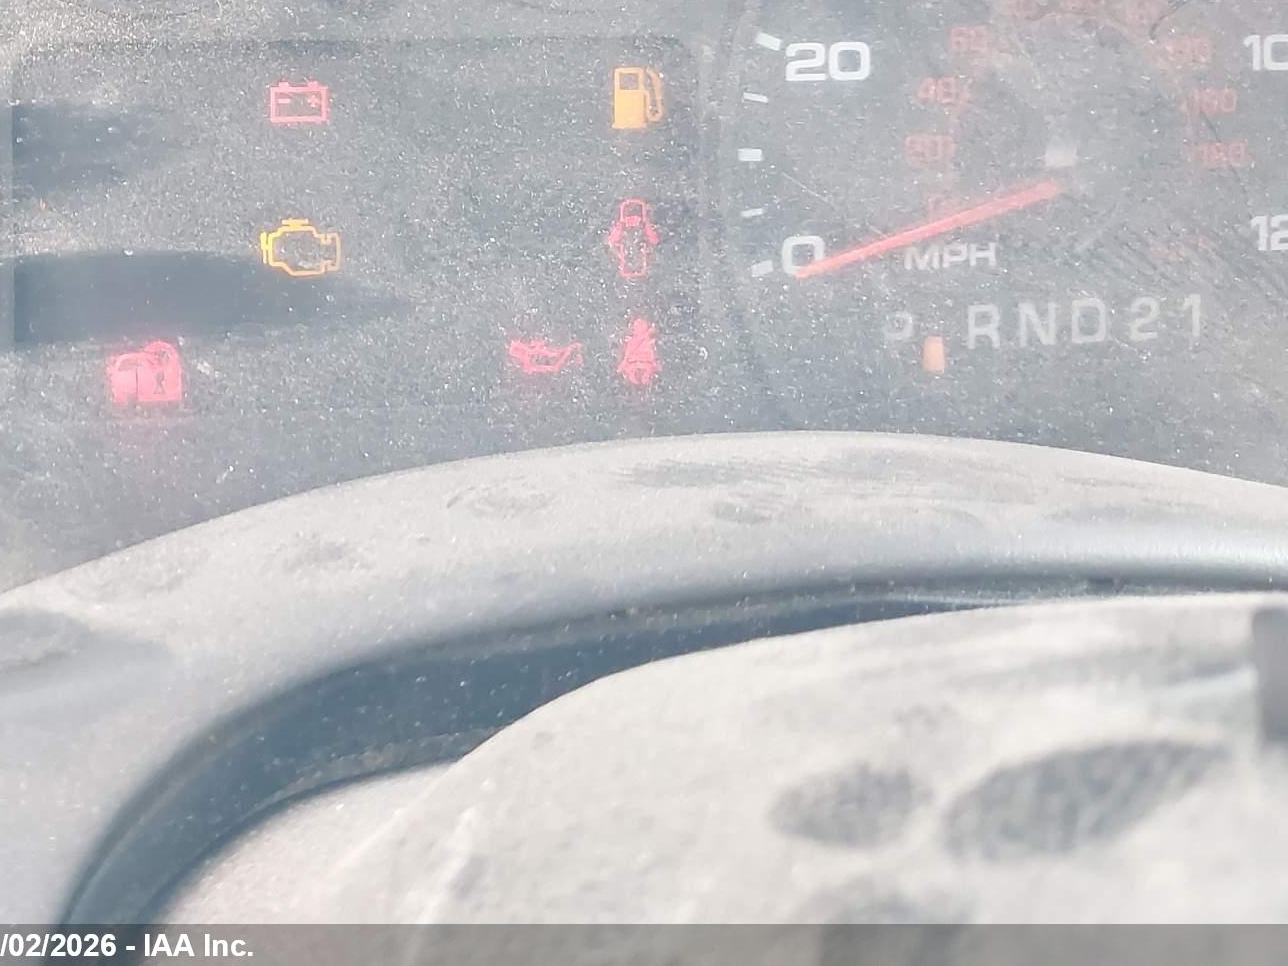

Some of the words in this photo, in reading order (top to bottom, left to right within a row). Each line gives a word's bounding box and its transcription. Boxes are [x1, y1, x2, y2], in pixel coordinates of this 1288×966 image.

[785, 41, 871, 82] 20
[781, 236, 825, 274] 0
[904, 241, 998, 271] MPH
